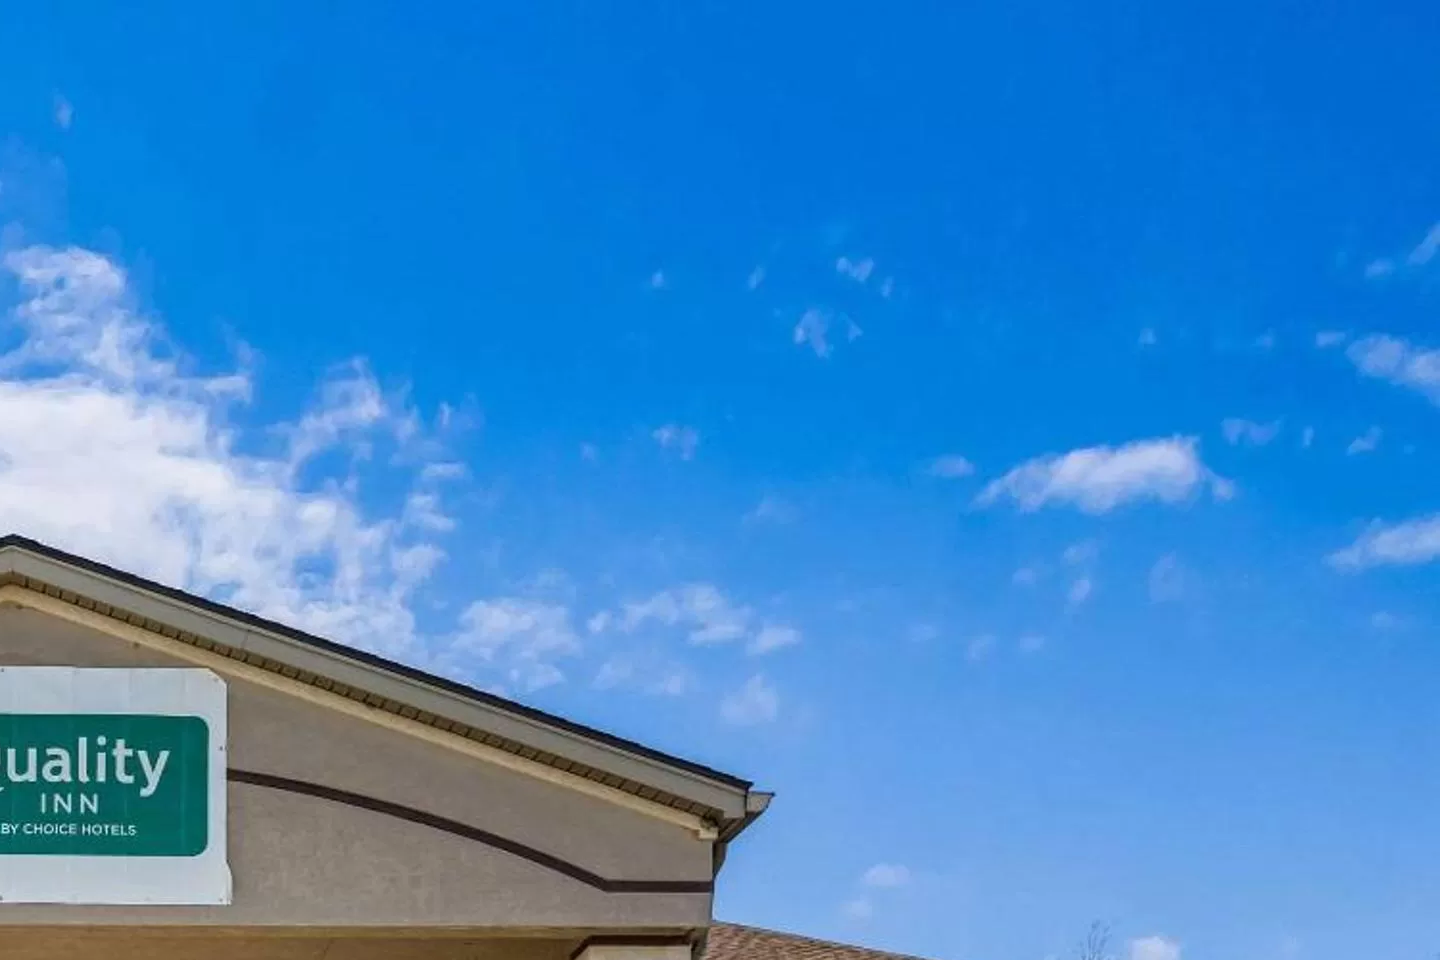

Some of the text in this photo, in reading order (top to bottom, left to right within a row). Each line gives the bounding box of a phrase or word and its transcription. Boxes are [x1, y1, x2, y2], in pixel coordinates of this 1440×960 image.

[40, 793, 99, 814] INN
[1, 823, 137, 836] BY CHOICE HOTELS
